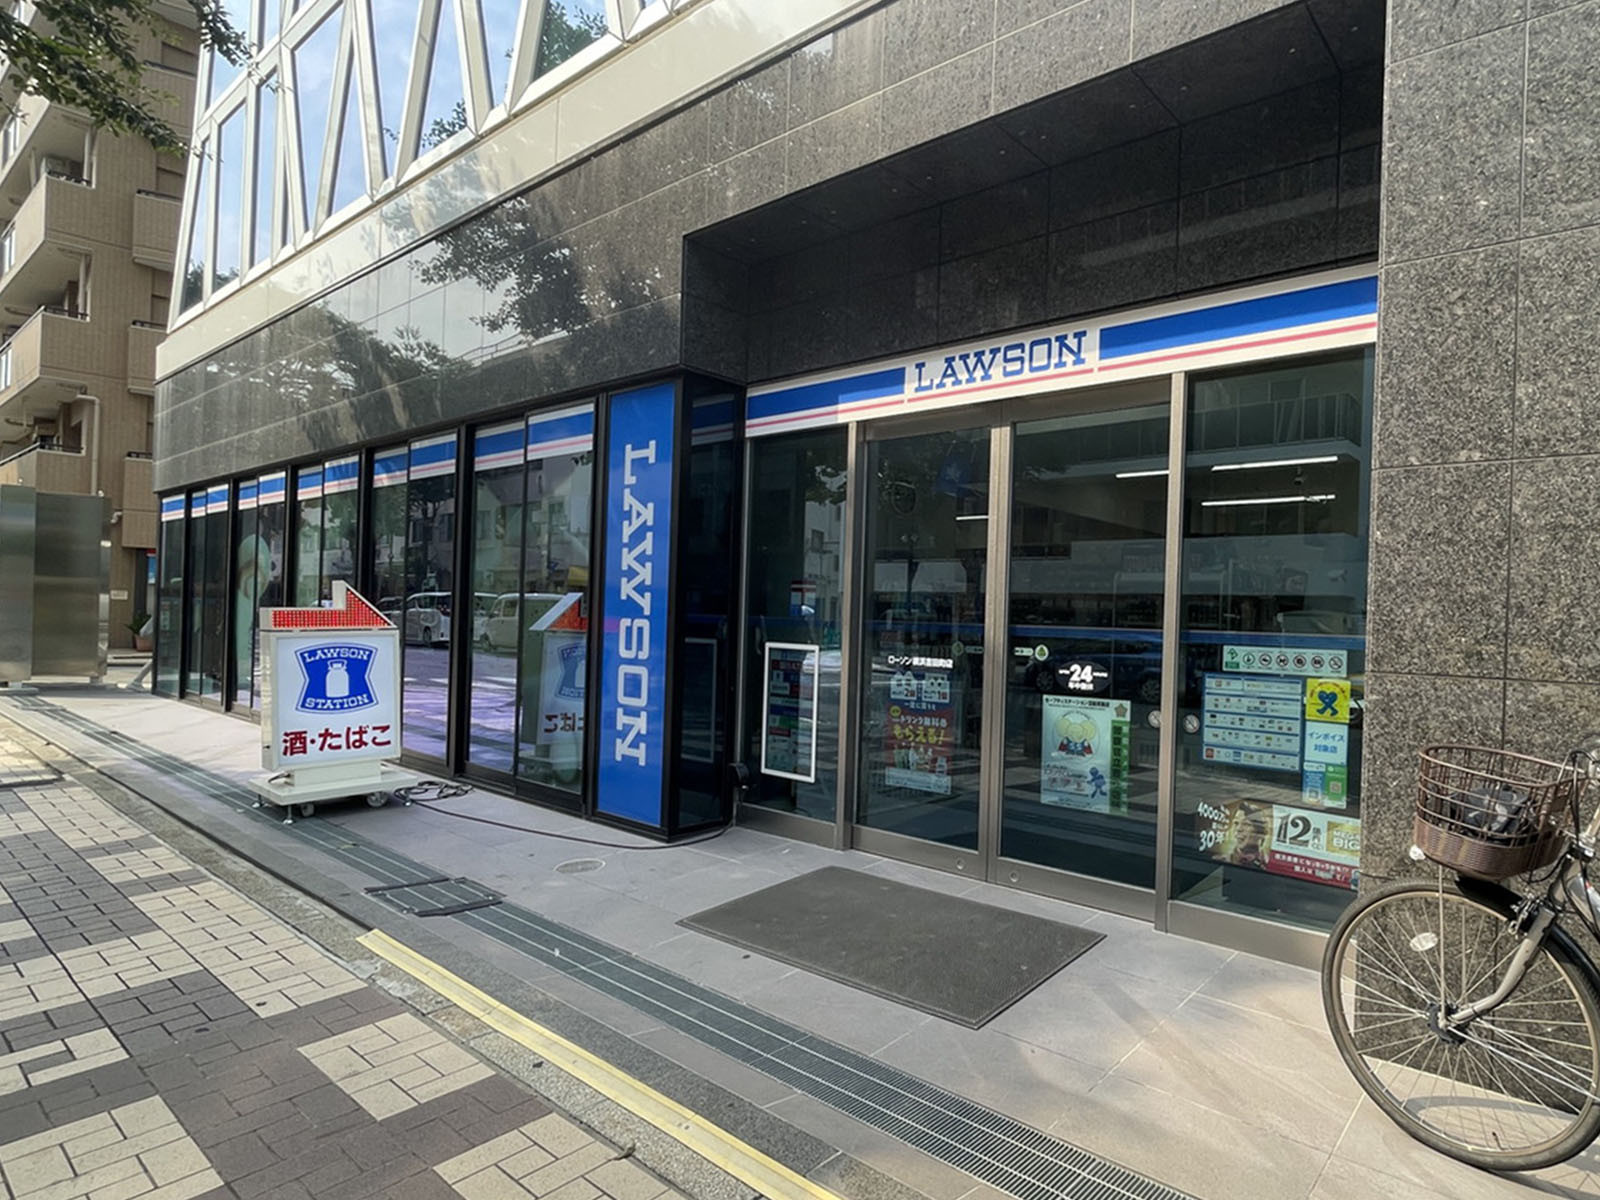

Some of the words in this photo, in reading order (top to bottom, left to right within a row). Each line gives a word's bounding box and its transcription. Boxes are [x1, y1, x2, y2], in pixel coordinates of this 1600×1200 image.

[914, 330, 1088, 393] LAWSON
[615, 440, 656, 767] LAWSON
[304, 647, 370, 662] LAWSON
[1070, 664, 1093, 682] 24
[304, 693, 370, 710] STATION
[282, 725, 391, 756] 酒・たばこ
[1308, 730, 1345, 742] インボイス
[1313, 743, 1338, 754] 対象店
